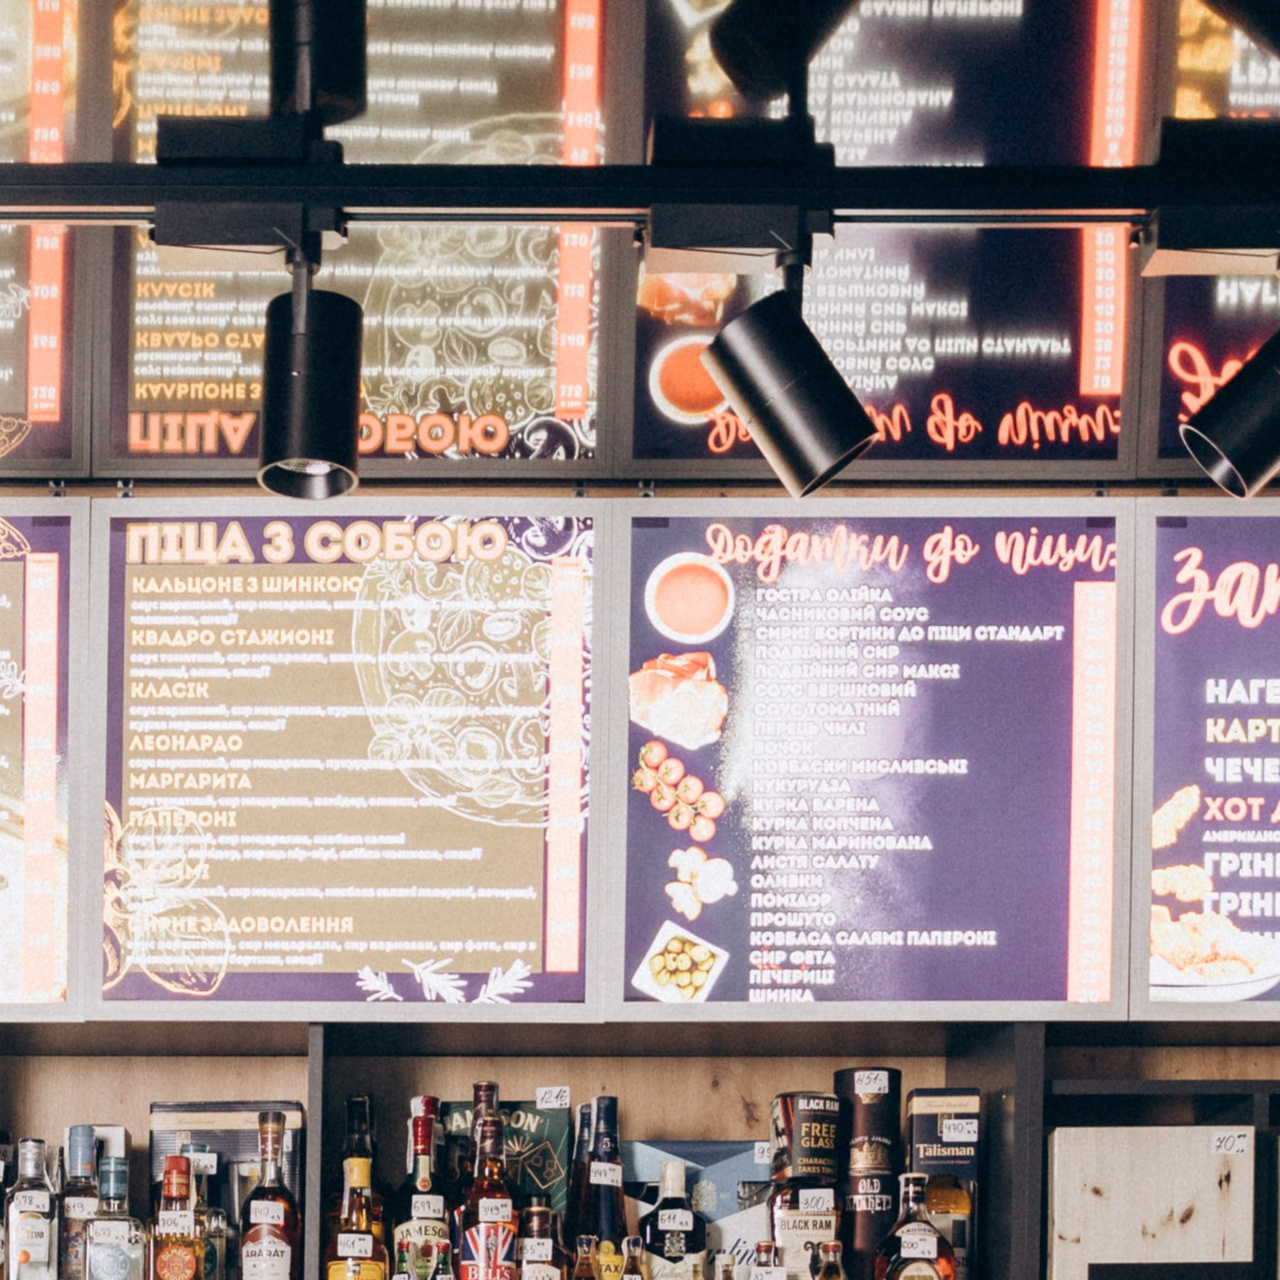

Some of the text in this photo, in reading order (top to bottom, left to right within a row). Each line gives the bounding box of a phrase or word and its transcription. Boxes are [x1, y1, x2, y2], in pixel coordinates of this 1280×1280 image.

[125, 520, 509, 566] ПІЦА З СОБОЮ
[132, 576, 244, 595] КАЛЬЦОНЕ
[263, 576, 363, 594] ШИНКОЮ
[131, 629, 335, 648] КВАДРО СТАЖИОНІ
[974, 625, 1066, 641] СТАНДАРТ
[130, 682, 210, 699] КЛАСІК
[128, 735, 243, 753] ЛЕОНАРДО
[129, 772, 253, 790] МАРГАРИТА
[1203, 796, 1266, 822] ХОТ
[1202, 851, 1280, 878] ГРІН
